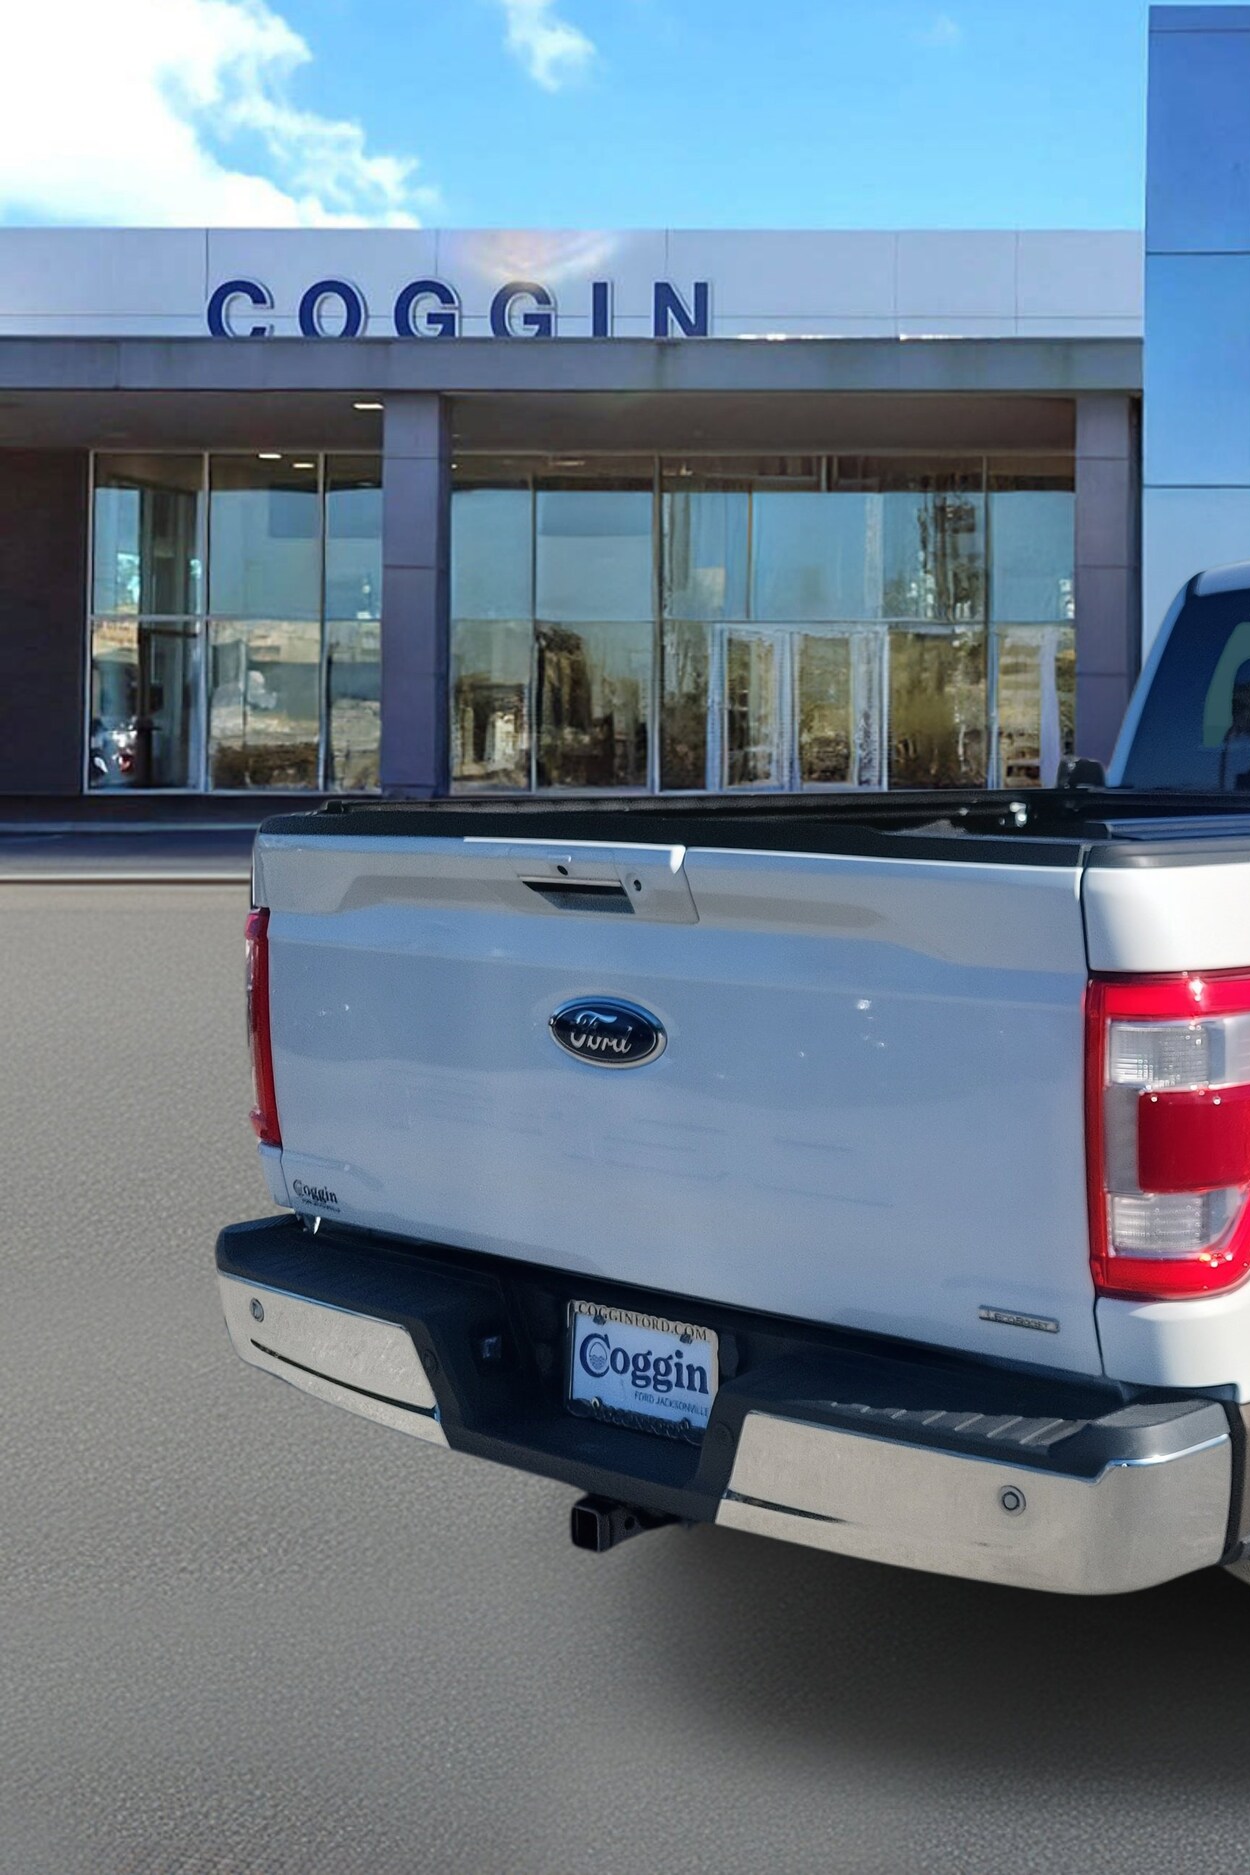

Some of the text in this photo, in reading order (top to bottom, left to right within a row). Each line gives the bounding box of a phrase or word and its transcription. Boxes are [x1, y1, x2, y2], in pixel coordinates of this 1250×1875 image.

[206, 279, 709, 338] COGGIN
[570, 1010, 632, 1053] Ford
[579, 1332, 709, 1395] Coggin
